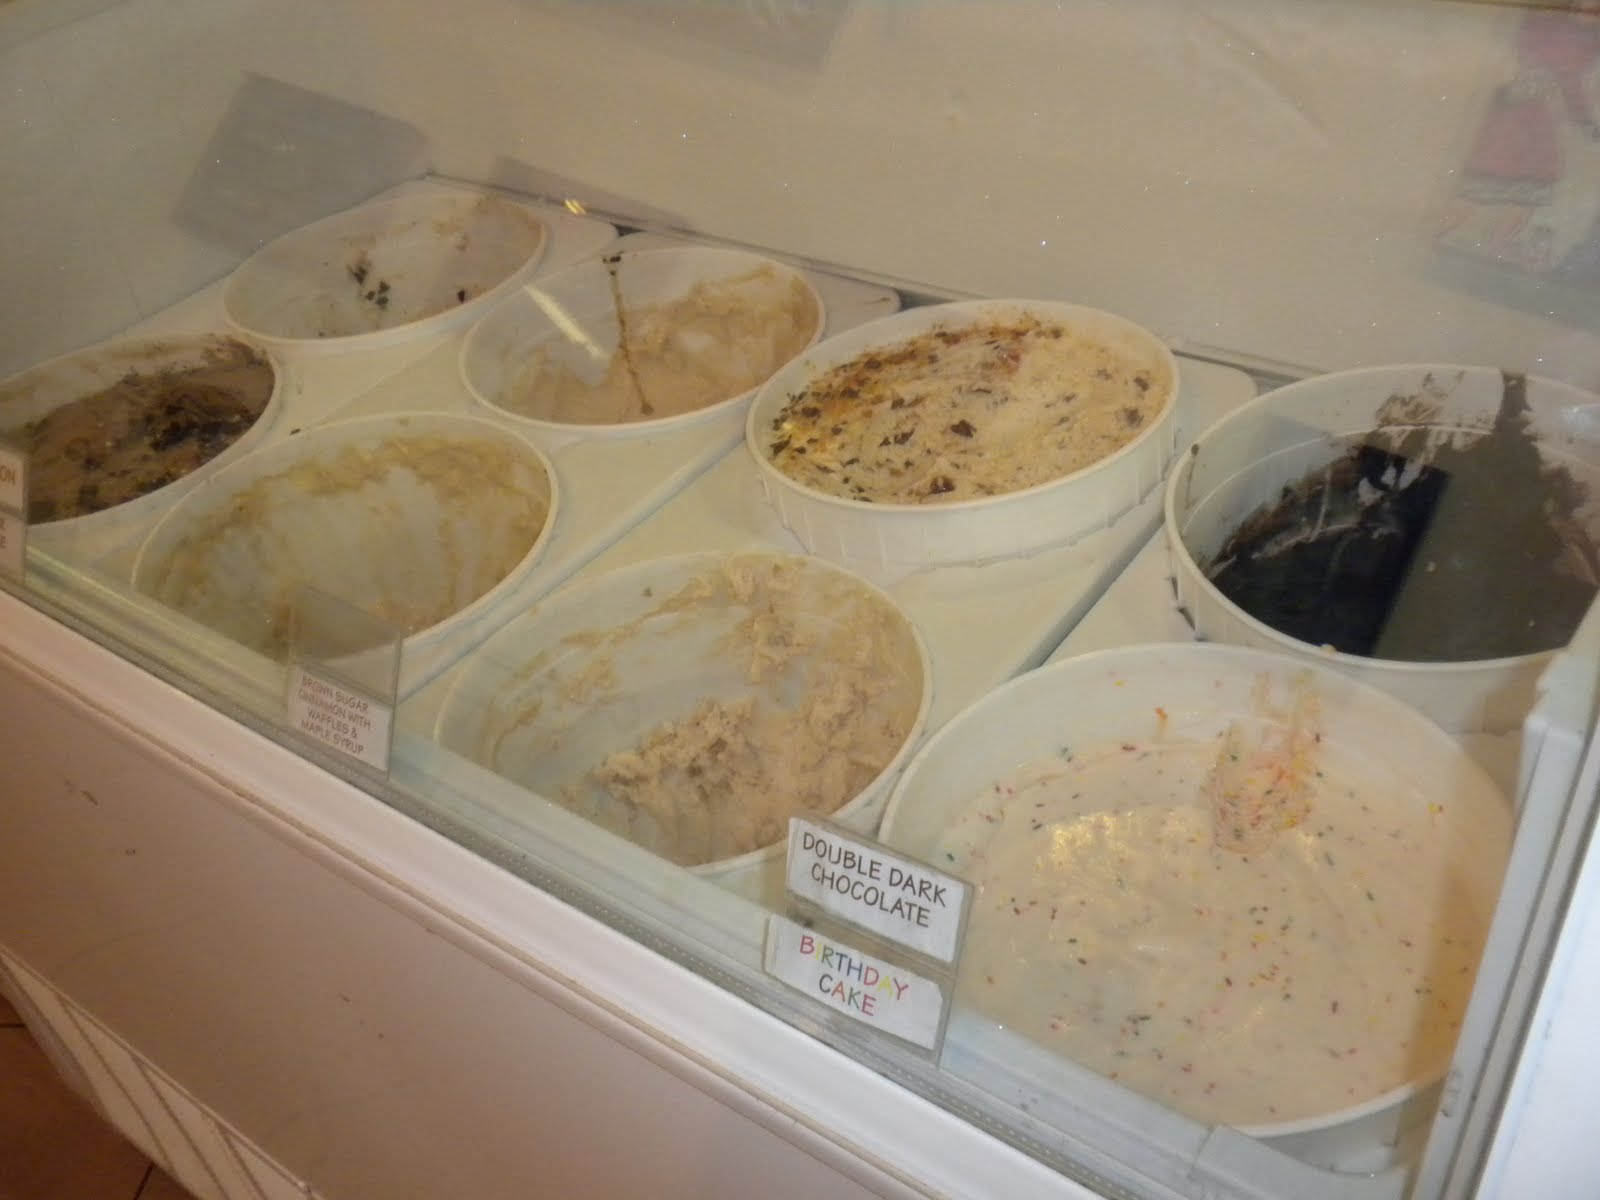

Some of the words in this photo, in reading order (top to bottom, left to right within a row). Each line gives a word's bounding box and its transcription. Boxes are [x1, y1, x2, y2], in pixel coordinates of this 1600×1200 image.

[302, 675, 333, 697] BROWN
[335, 691, 368, 713] SUGAR
[301, 720, 330, 739] MAPLE
[333, 734, 364, 755] SYRUP
[307, 707, 349, 735] WAFFLES
[348, 713, 370, 731] WITH
[802, 831, 882, 880] DOUBLE
[889, 867, 947, 908] DARK
[811, 862, 930, 928] CHOCOLATE
[799, 935, 909, 1001] BIRTHDAY
[819, 974, 877, 1017] CAKE
